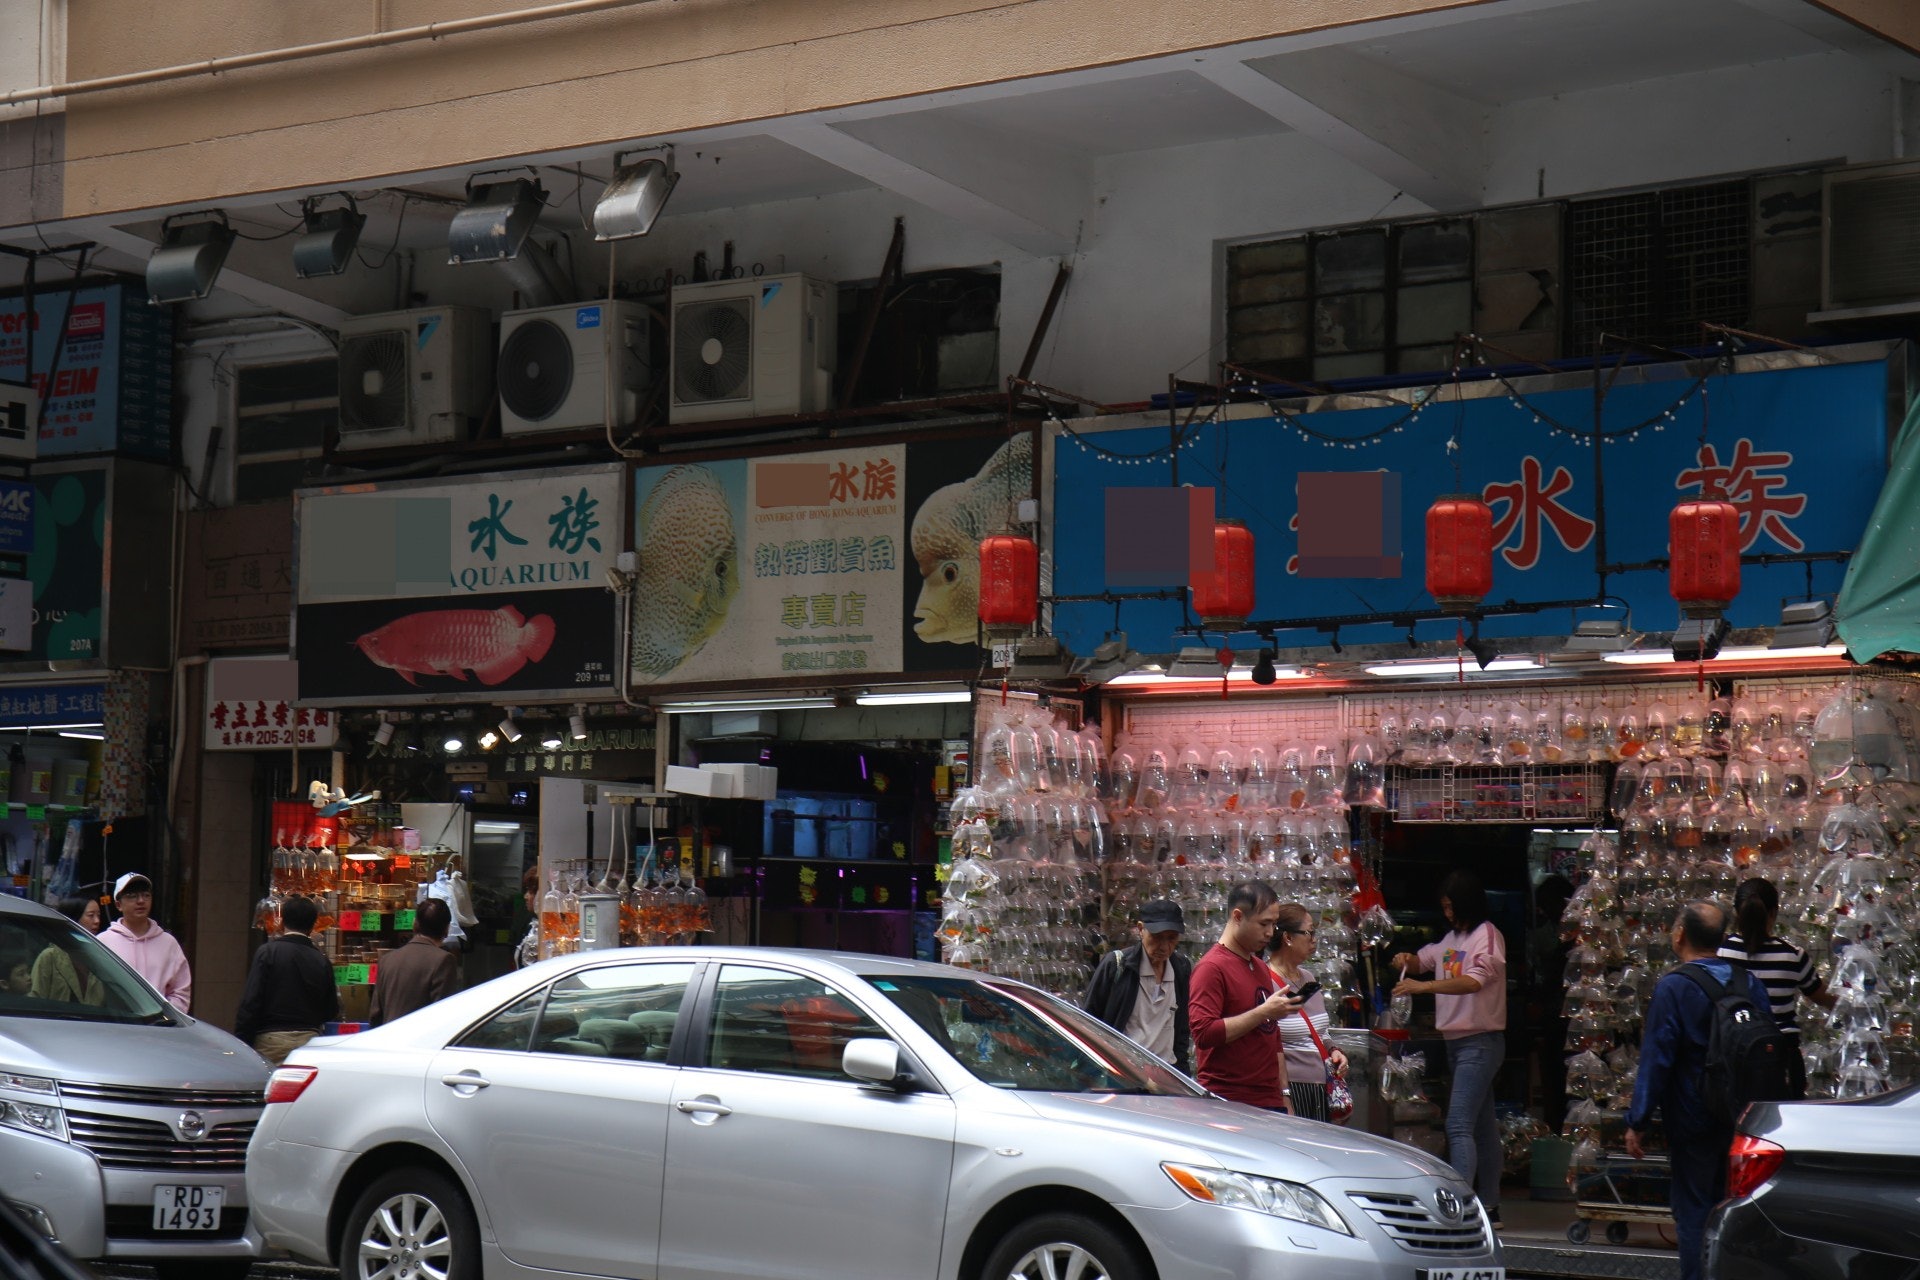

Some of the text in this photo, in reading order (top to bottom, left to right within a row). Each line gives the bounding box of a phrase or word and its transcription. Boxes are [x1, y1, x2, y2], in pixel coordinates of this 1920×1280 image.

[829, 458, 897, 503] 水族
[796, 510, 806, 521] OF
[809, 509, 829, 520] HONG
[832, 508, 853, 519] KONG
[856, 505, 897, 518] AQUARIUM
[1482, 437, 1808, 571] 水族
[468, 487, 602, 561] 水族
[754, 535, 896, 577] 熱帶觀賞魚
[781, 590, 867, 629] 專賣店
[70, 639, 92, 651] 207A
[576, 672, 591, 682] 209
[175, 1186, 203, 1208] RD
[159, 1207, 214, 1229] 1493
